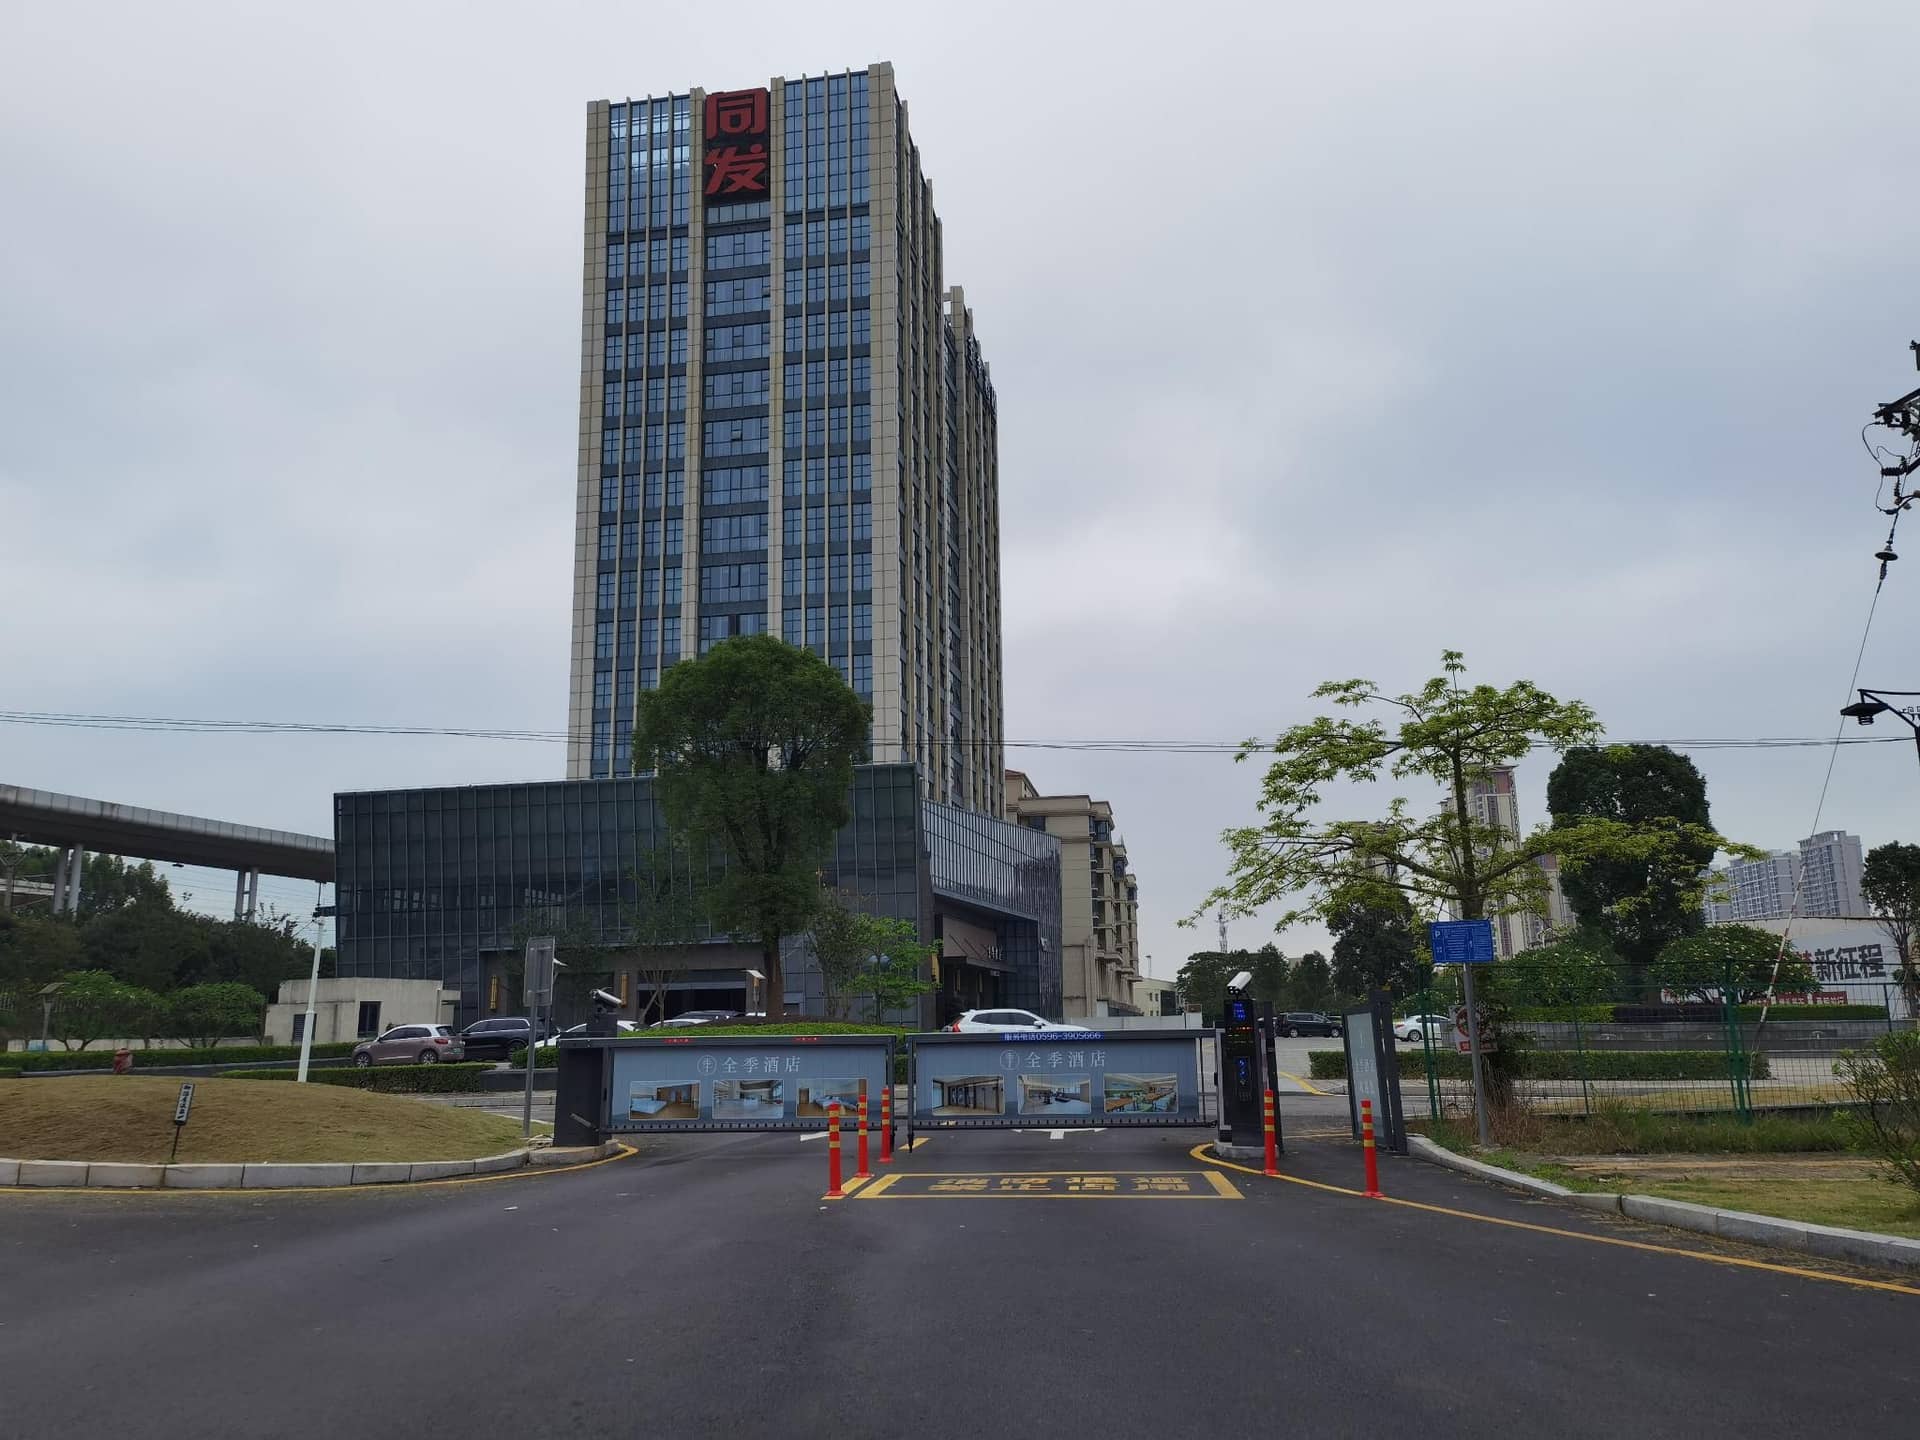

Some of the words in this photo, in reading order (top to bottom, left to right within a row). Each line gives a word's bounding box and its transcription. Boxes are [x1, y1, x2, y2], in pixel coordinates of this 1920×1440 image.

[705, 88, 767, 195] 同发
[1795, 943, 1887, 982] 新征程
[722, 1055, 800, 1073] 全季酒店
[1024, 1050, 1106, 1069] 全季酒店
